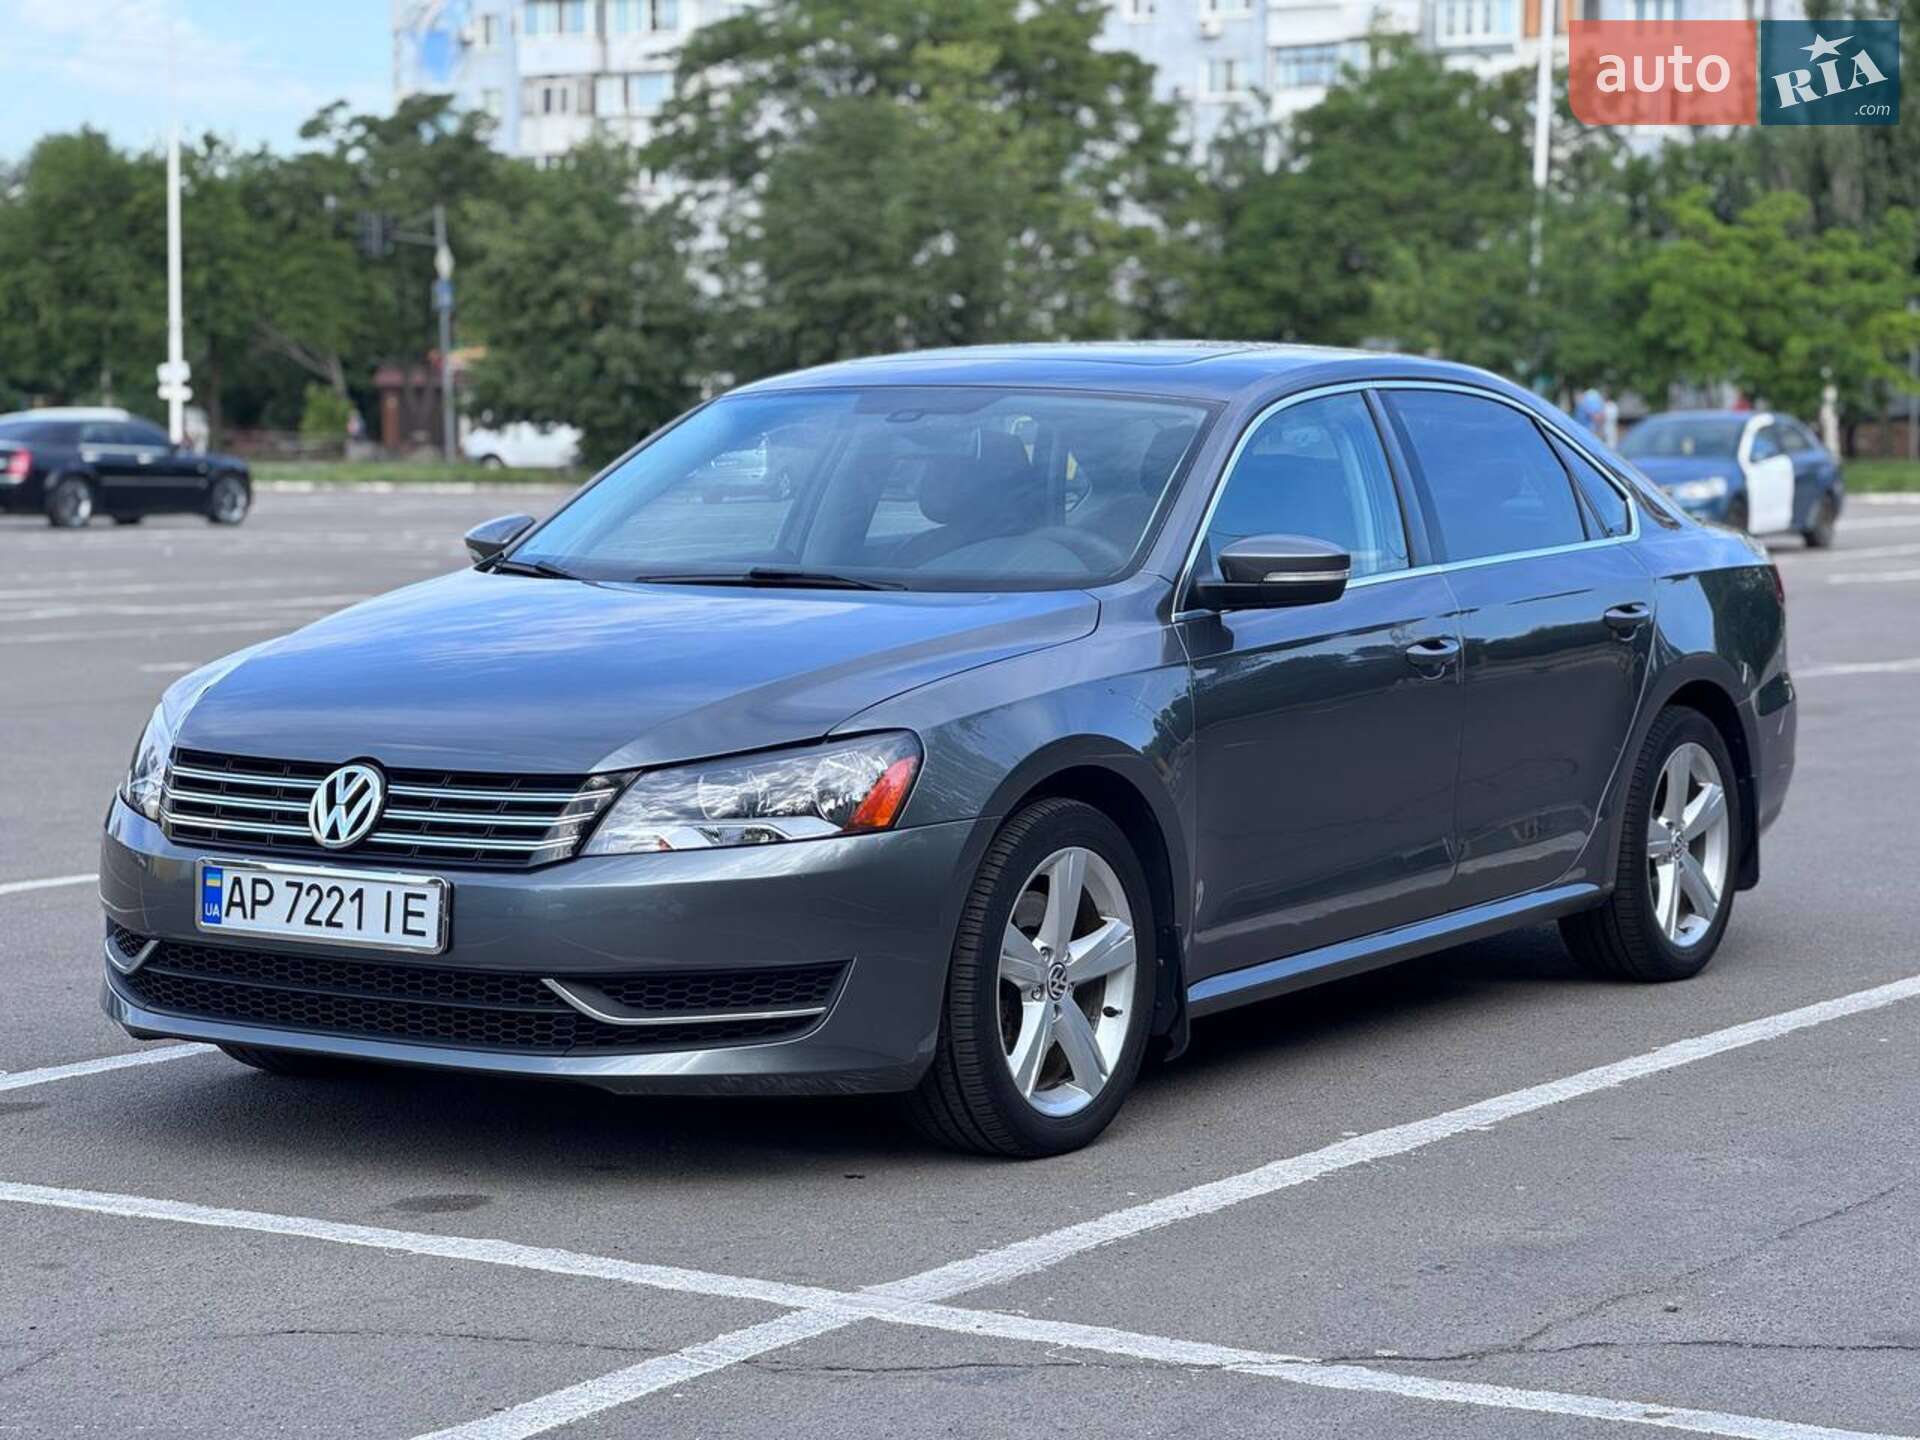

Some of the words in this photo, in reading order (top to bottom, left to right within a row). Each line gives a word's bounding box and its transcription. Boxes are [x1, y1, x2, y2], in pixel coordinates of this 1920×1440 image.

[204, 903, 221, 918] UA
[224, 876, 275, 920] AP
[285, 880, 364, 931] 7221
[384, 890, 428, 937] IE
